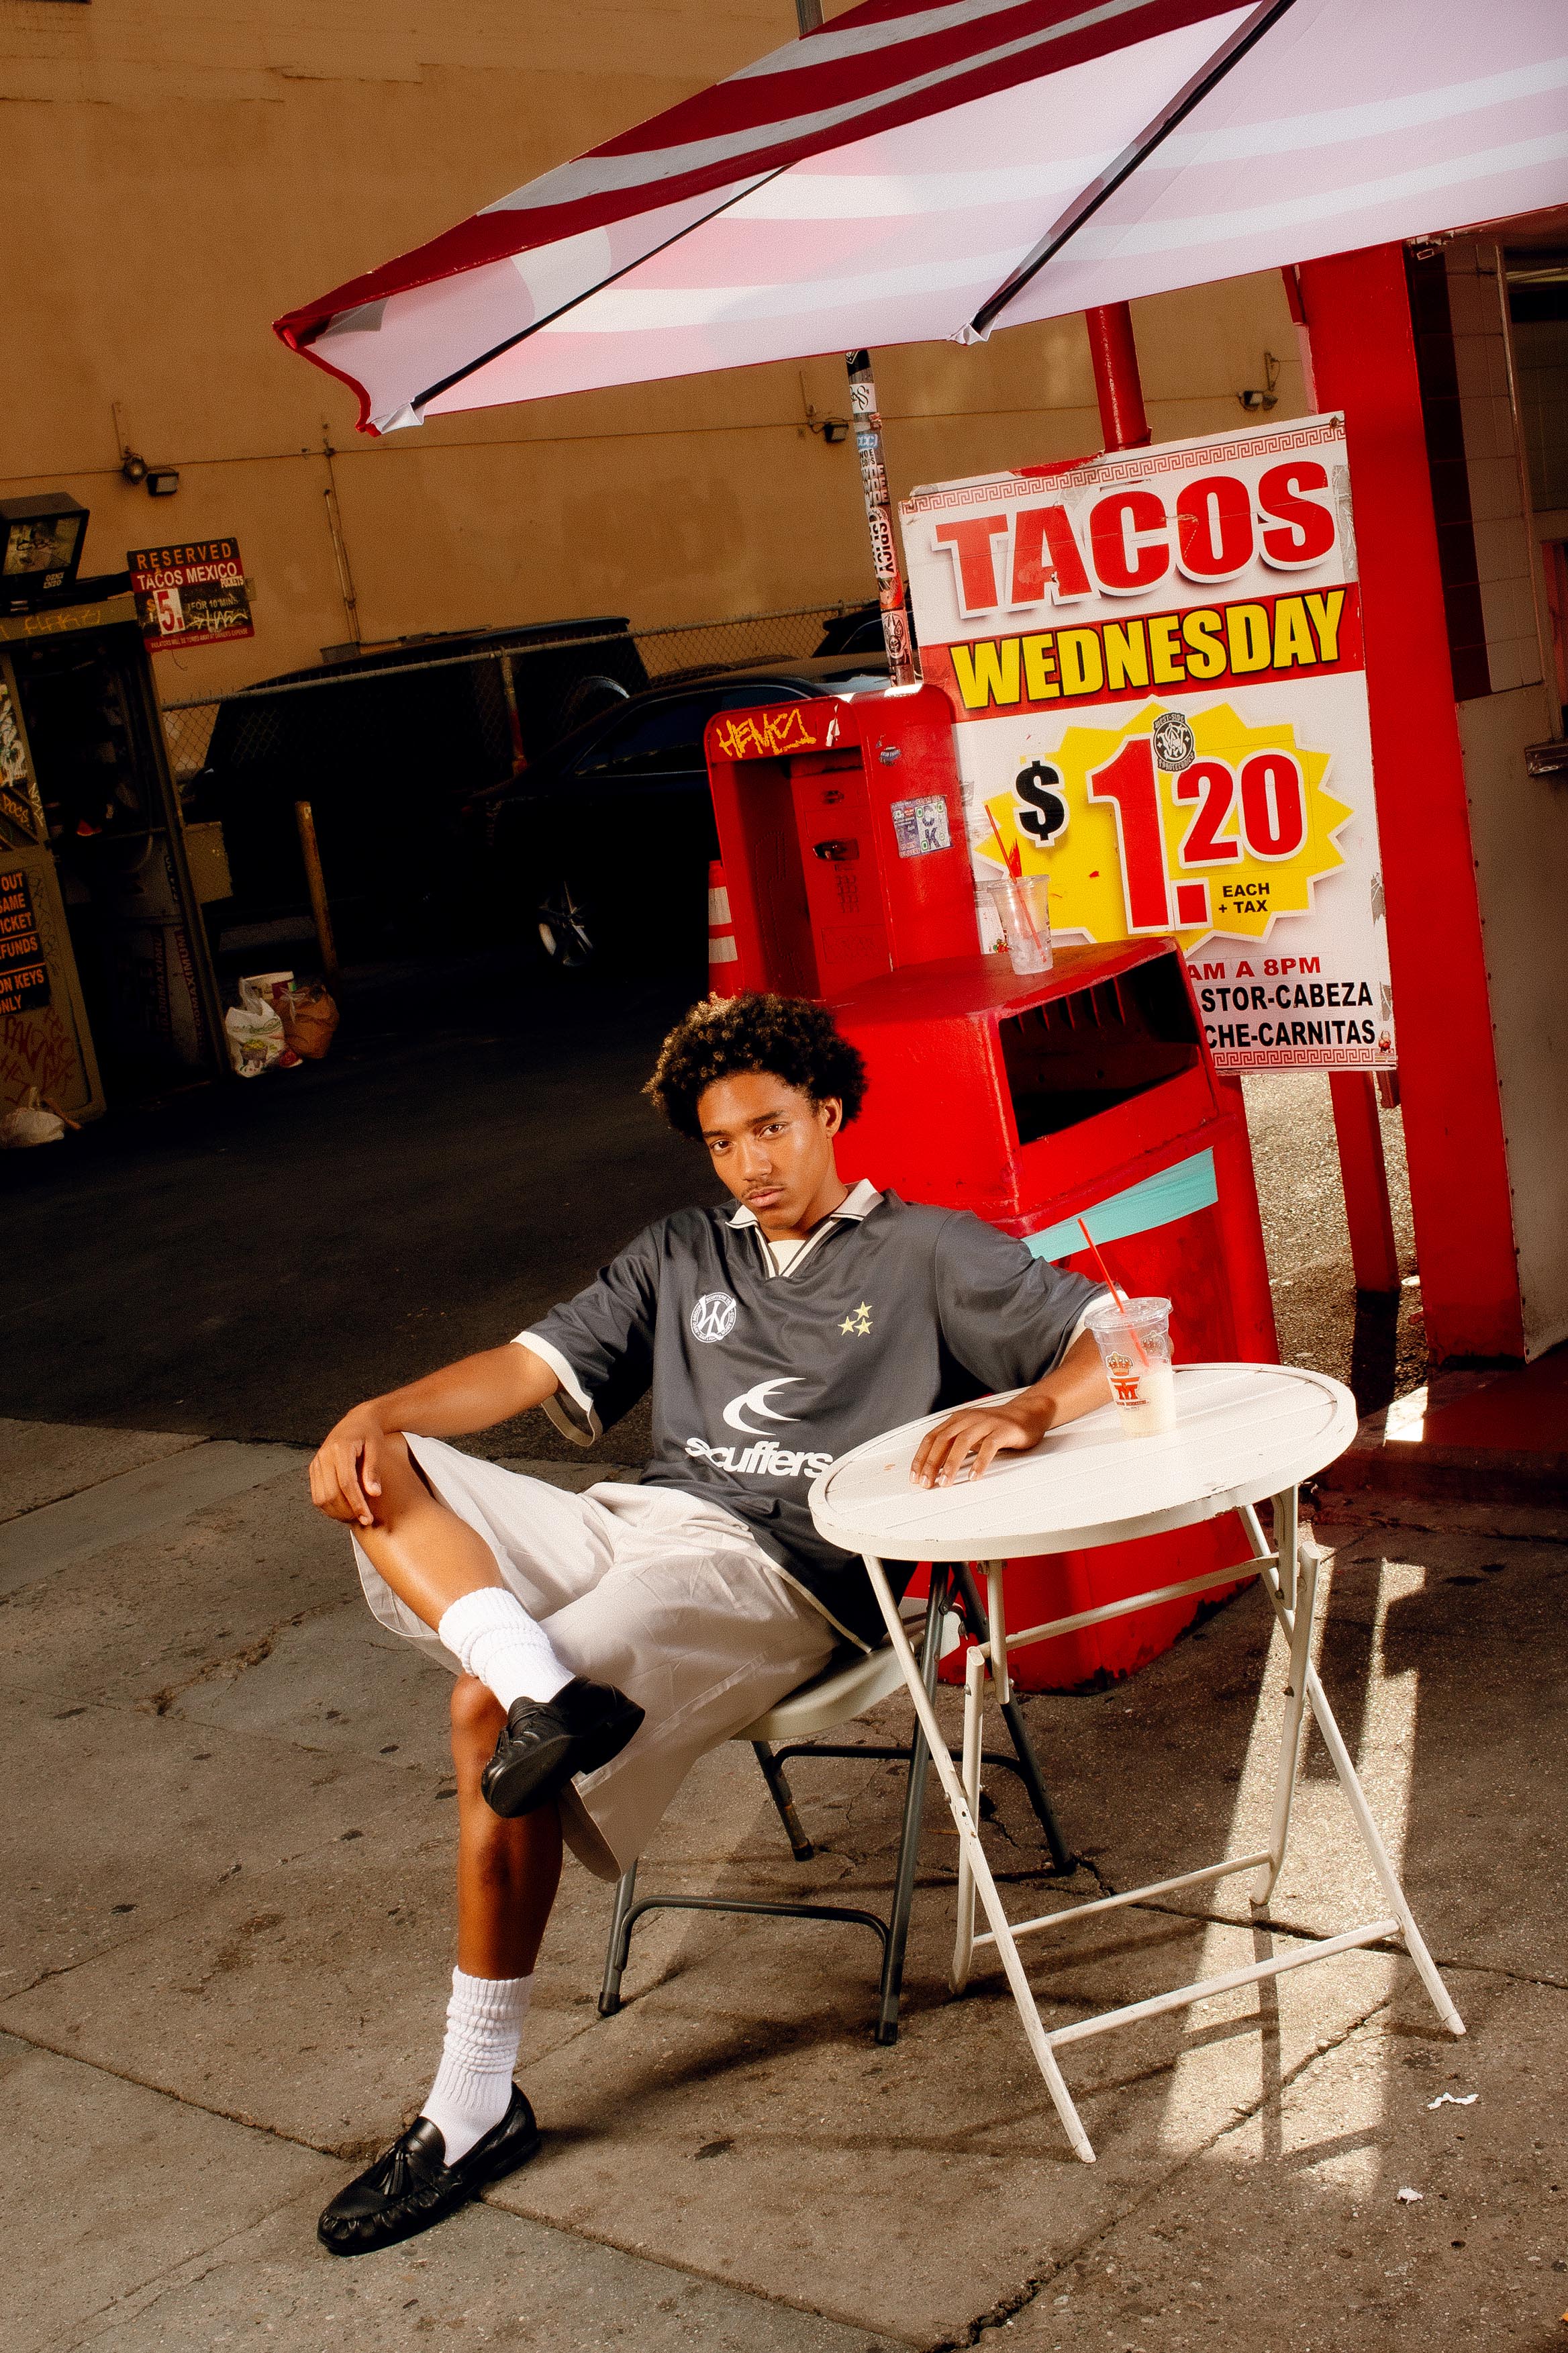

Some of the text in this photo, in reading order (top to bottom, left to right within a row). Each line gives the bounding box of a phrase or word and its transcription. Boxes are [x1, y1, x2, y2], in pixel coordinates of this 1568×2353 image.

[936, 461, 1335, 611] TACOS
[136, 542, 232, 570] RESERVED
[873, 522, 895, 573] SPICY
[137, 562, 237, 590] TACOS MEXICO
[191, 600, 208, 610] FOR
[950, 589, 1345, 710] WEDNESDAY
[1, 872, 23, 892] OUT
[1223, 881, 1271, 898] EACH
[1233, 900, 1268, 914] TAX
[0, 912, 32, 934] ICKET
[0, 936, 38, 961] FUNDS
[1236, 961, 1255, 978] A
[1264, 957, 1321, 976] 8PM
[14, 969, 44, 990] KEYS
[0, 994, 21, 1015] NLY
[1199, 981, 1373, 1013] STOR-CABEZA
